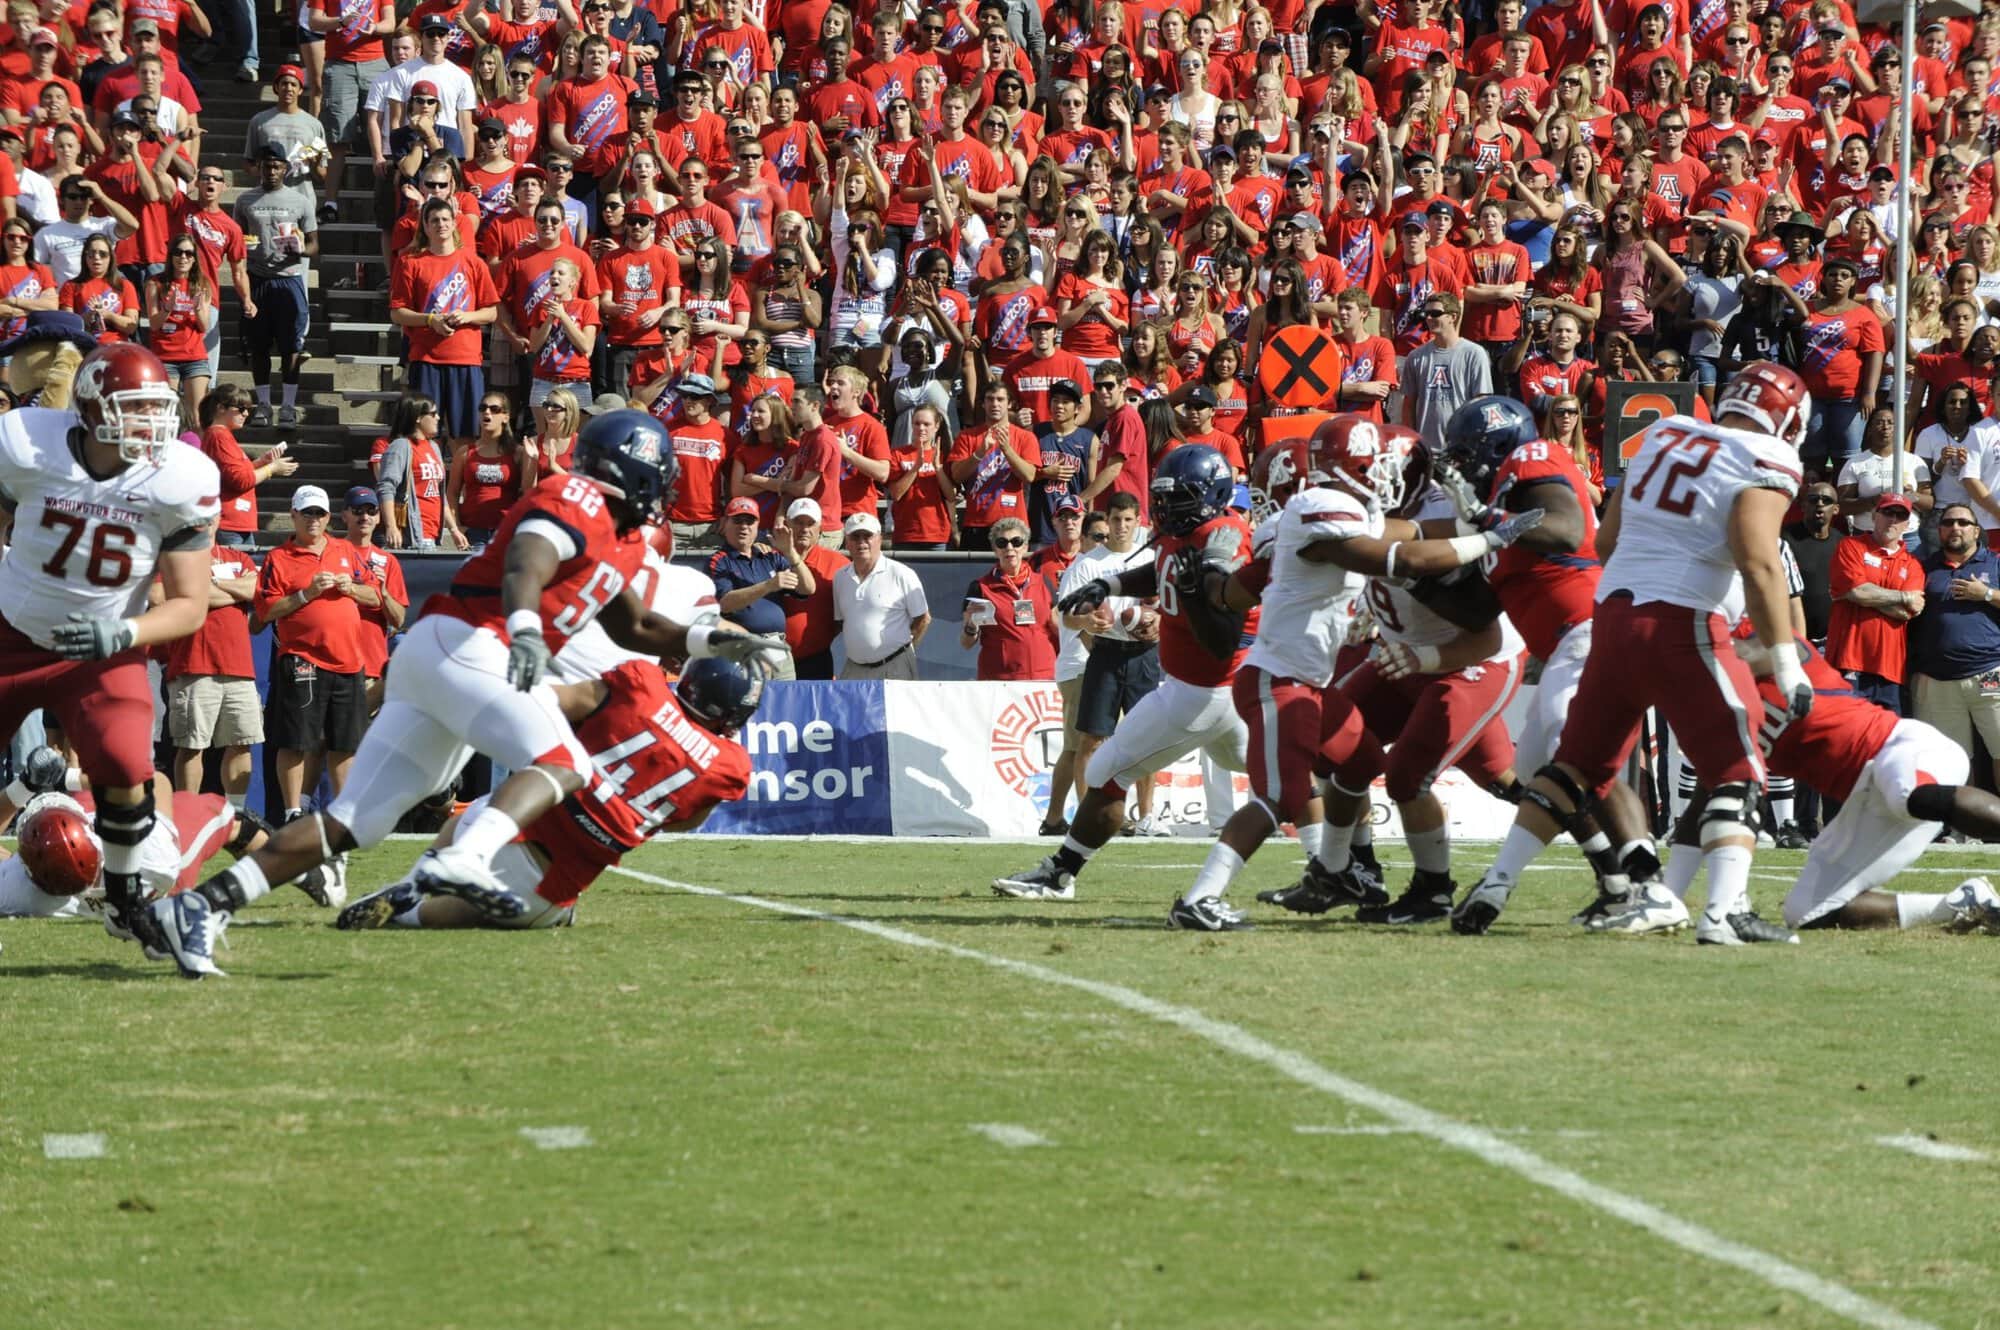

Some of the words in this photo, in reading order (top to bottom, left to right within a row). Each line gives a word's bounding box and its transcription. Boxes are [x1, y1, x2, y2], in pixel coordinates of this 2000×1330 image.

[1475, 144, 1502, 173] A
[1656, 174, 1682, 201] A
[735, 199, 771, 256] A
[431, 272, 465, 314] ONZOO
[1427, 364, 1453, 389] A
[1619, 393, 1678, 459] 2
[1630, 427, 1721, 517] 72
[44, 496, 109, 517] WASHINGTON
[112, 508, 144, 522] STATE
[561, 477, 605, 518] 52
[40, 509, 136, 588] 76
[651, 701, 720, 771] ELMORE
[744, 719, 835, 754] me
[590, 729, 698, 838] 44
[750, 765, 873, 801] nsor
